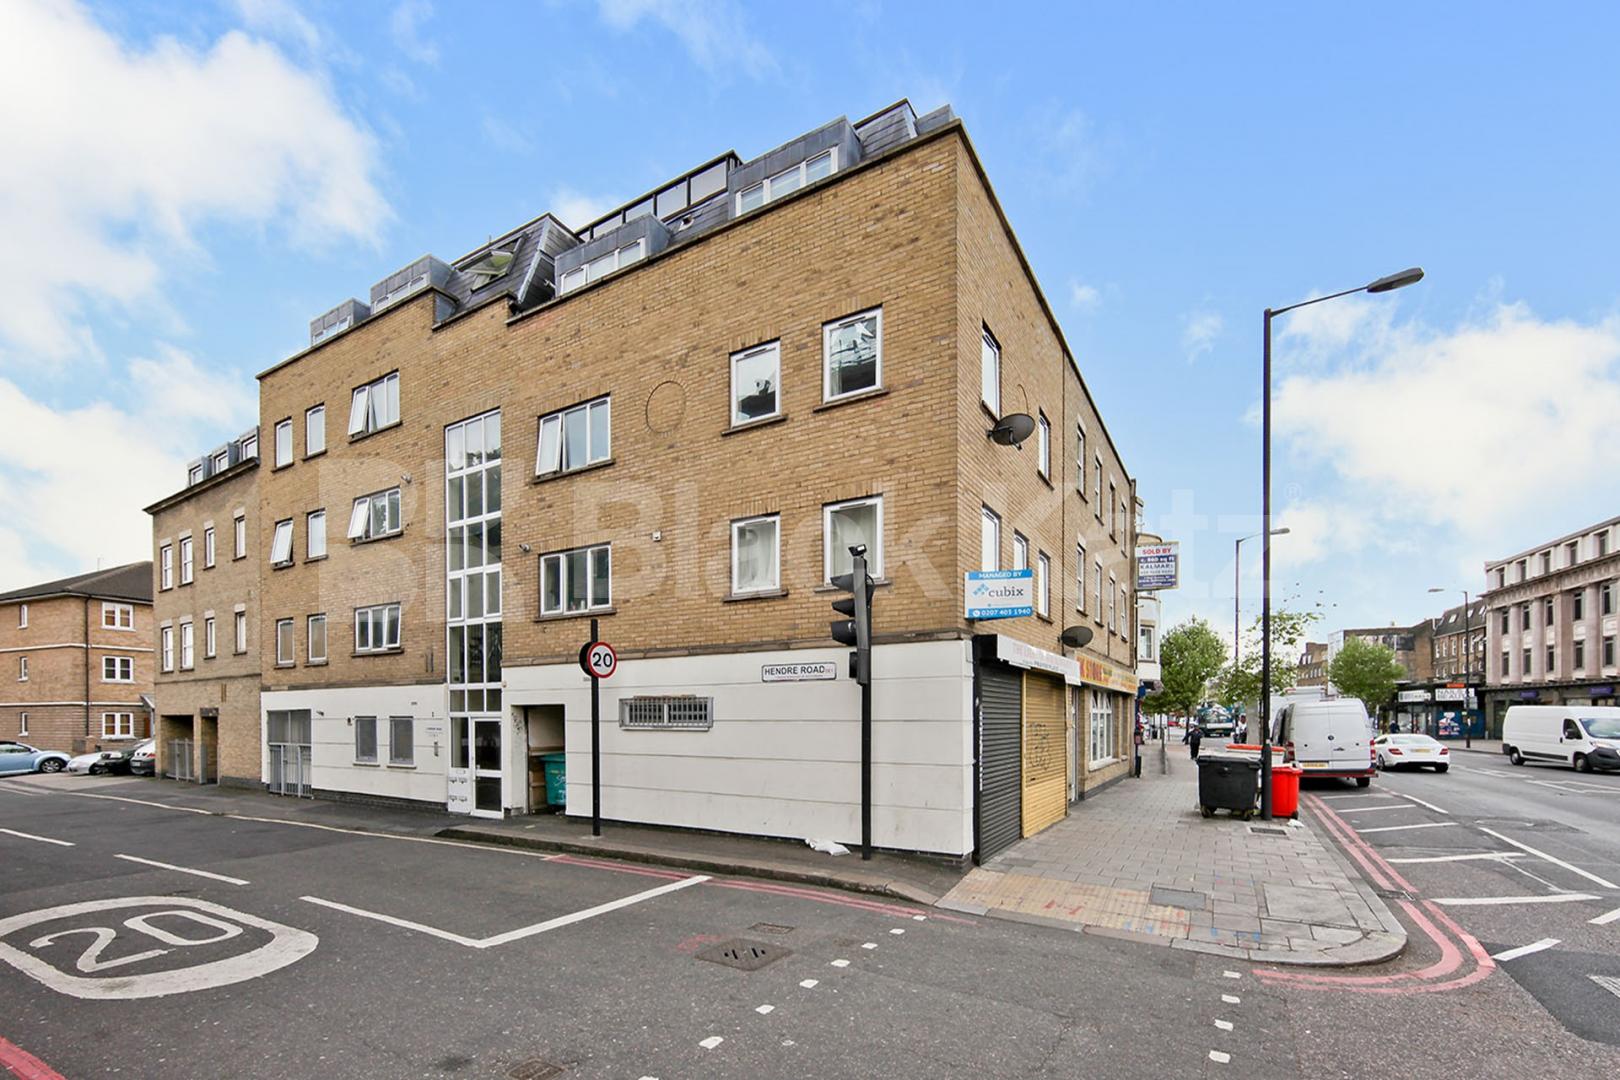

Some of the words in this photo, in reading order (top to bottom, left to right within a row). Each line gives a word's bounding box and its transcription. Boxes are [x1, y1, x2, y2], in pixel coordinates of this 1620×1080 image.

[988, 585, 1024, 597] cubix
[592, 652, 613, 668] 20
[764, 666, 799, 676] HENDRE
[800, 665, 825, 674] ROAD
[29, 909, 244, 973] 20
